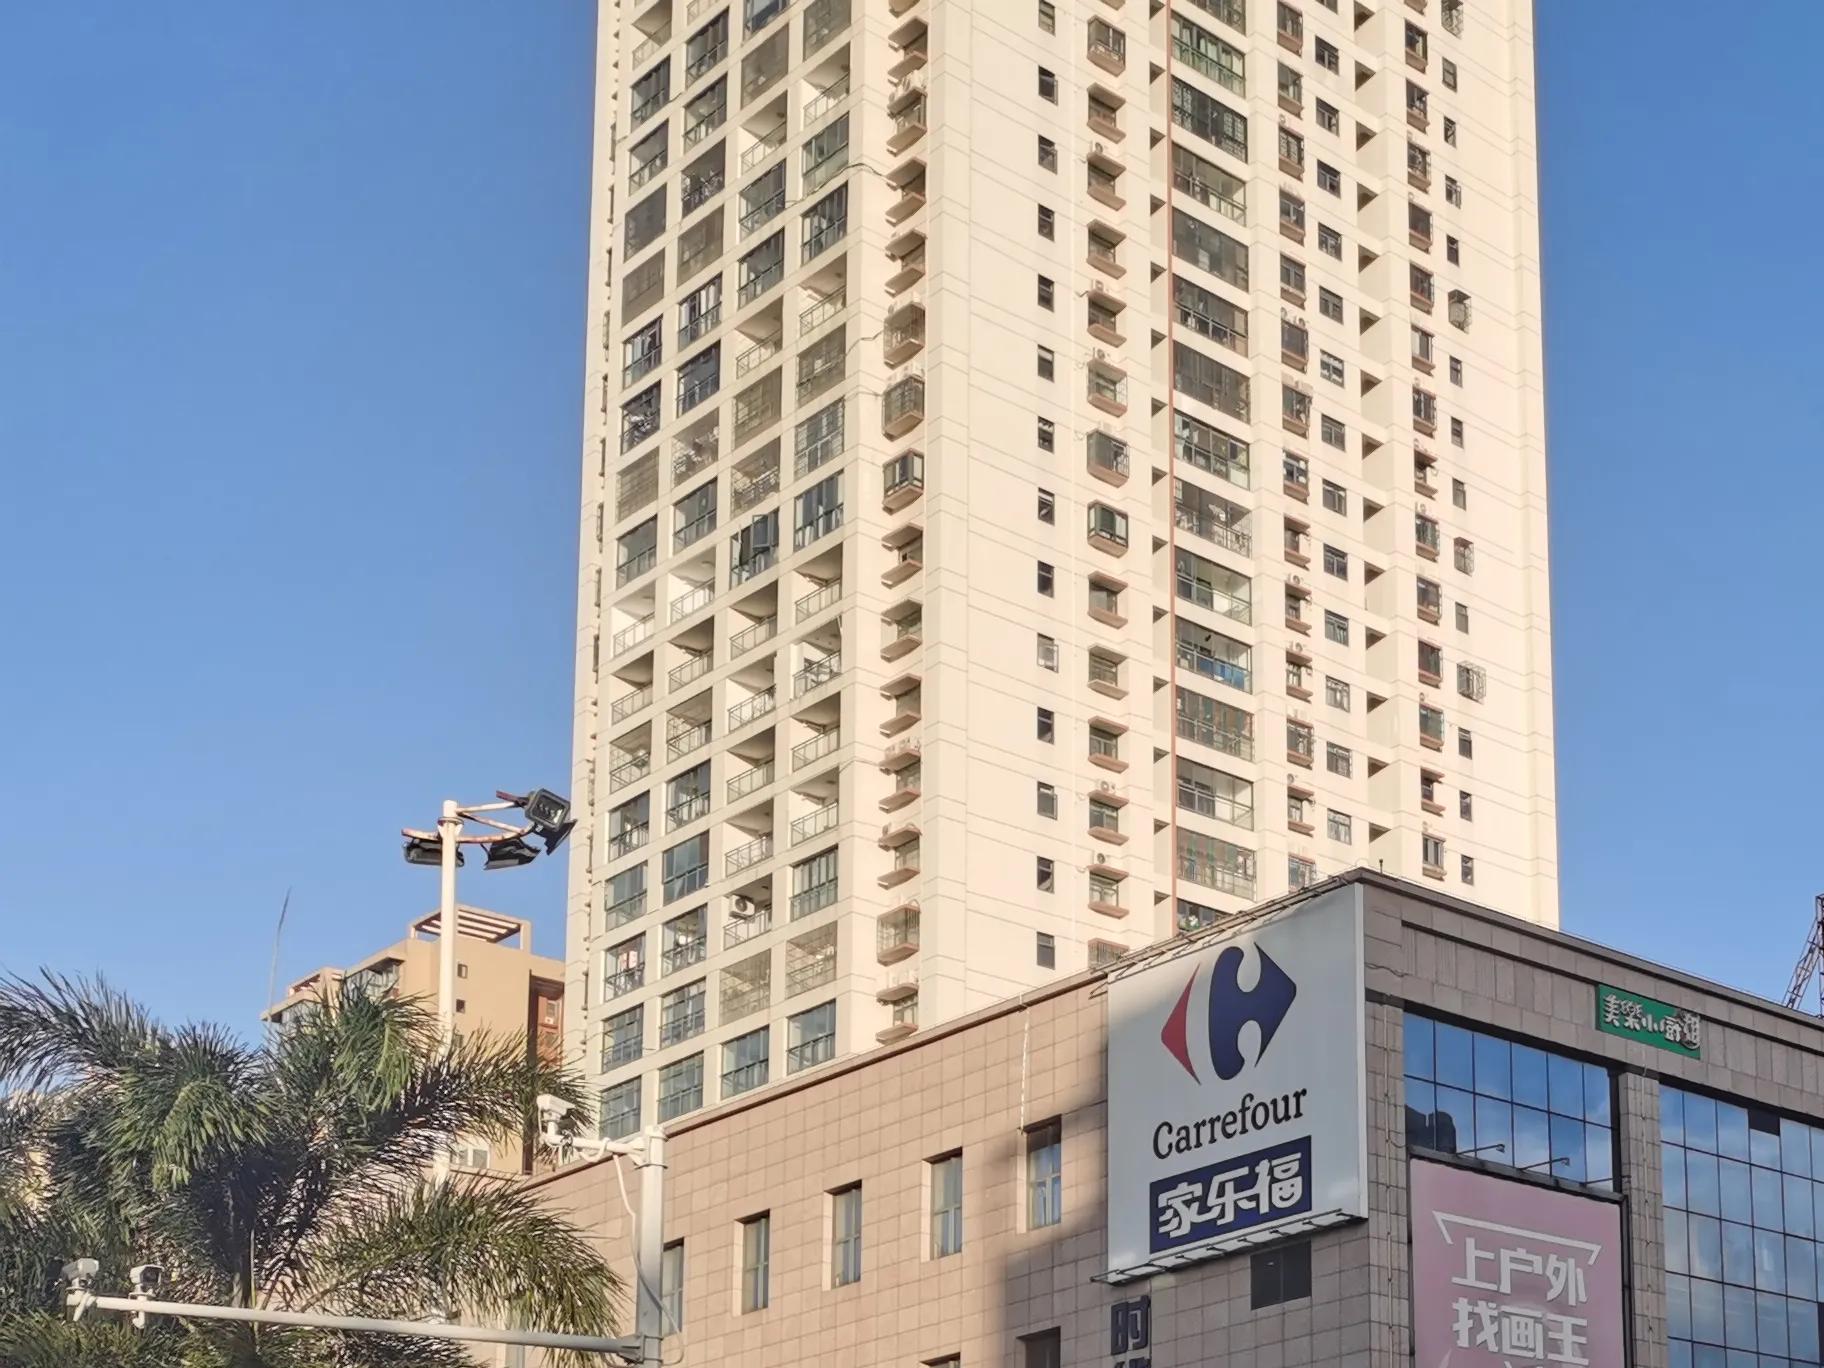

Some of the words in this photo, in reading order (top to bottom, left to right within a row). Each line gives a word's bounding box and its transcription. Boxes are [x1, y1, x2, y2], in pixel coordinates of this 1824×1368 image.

[1153, 1088, 1307, 1160] Carrefour
[1157, 1152, 1303, 1238] 家乐福
[1452, 1236, 1588, 1306] 上户外
[1452, 1298, 1589, 1368] 找画王
